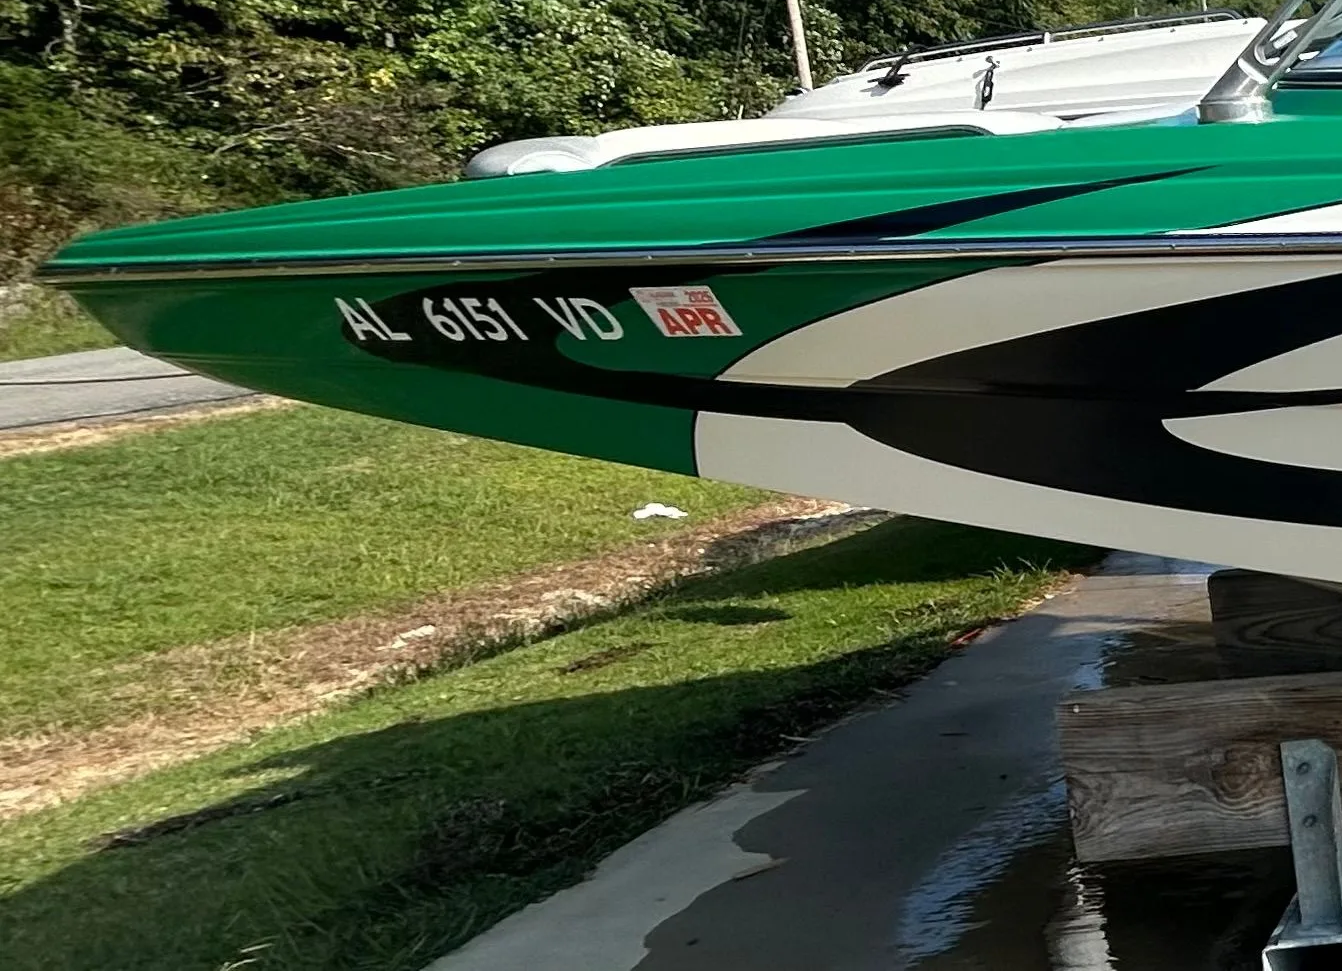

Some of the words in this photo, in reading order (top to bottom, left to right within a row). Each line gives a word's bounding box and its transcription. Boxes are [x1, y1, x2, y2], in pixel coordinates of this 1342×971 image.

[334, 297, 412, 341] AL
[422, 297, 529, 341] 6151
[532, 297, 625, 341] VD
[657, 308, 733, 335] APR
